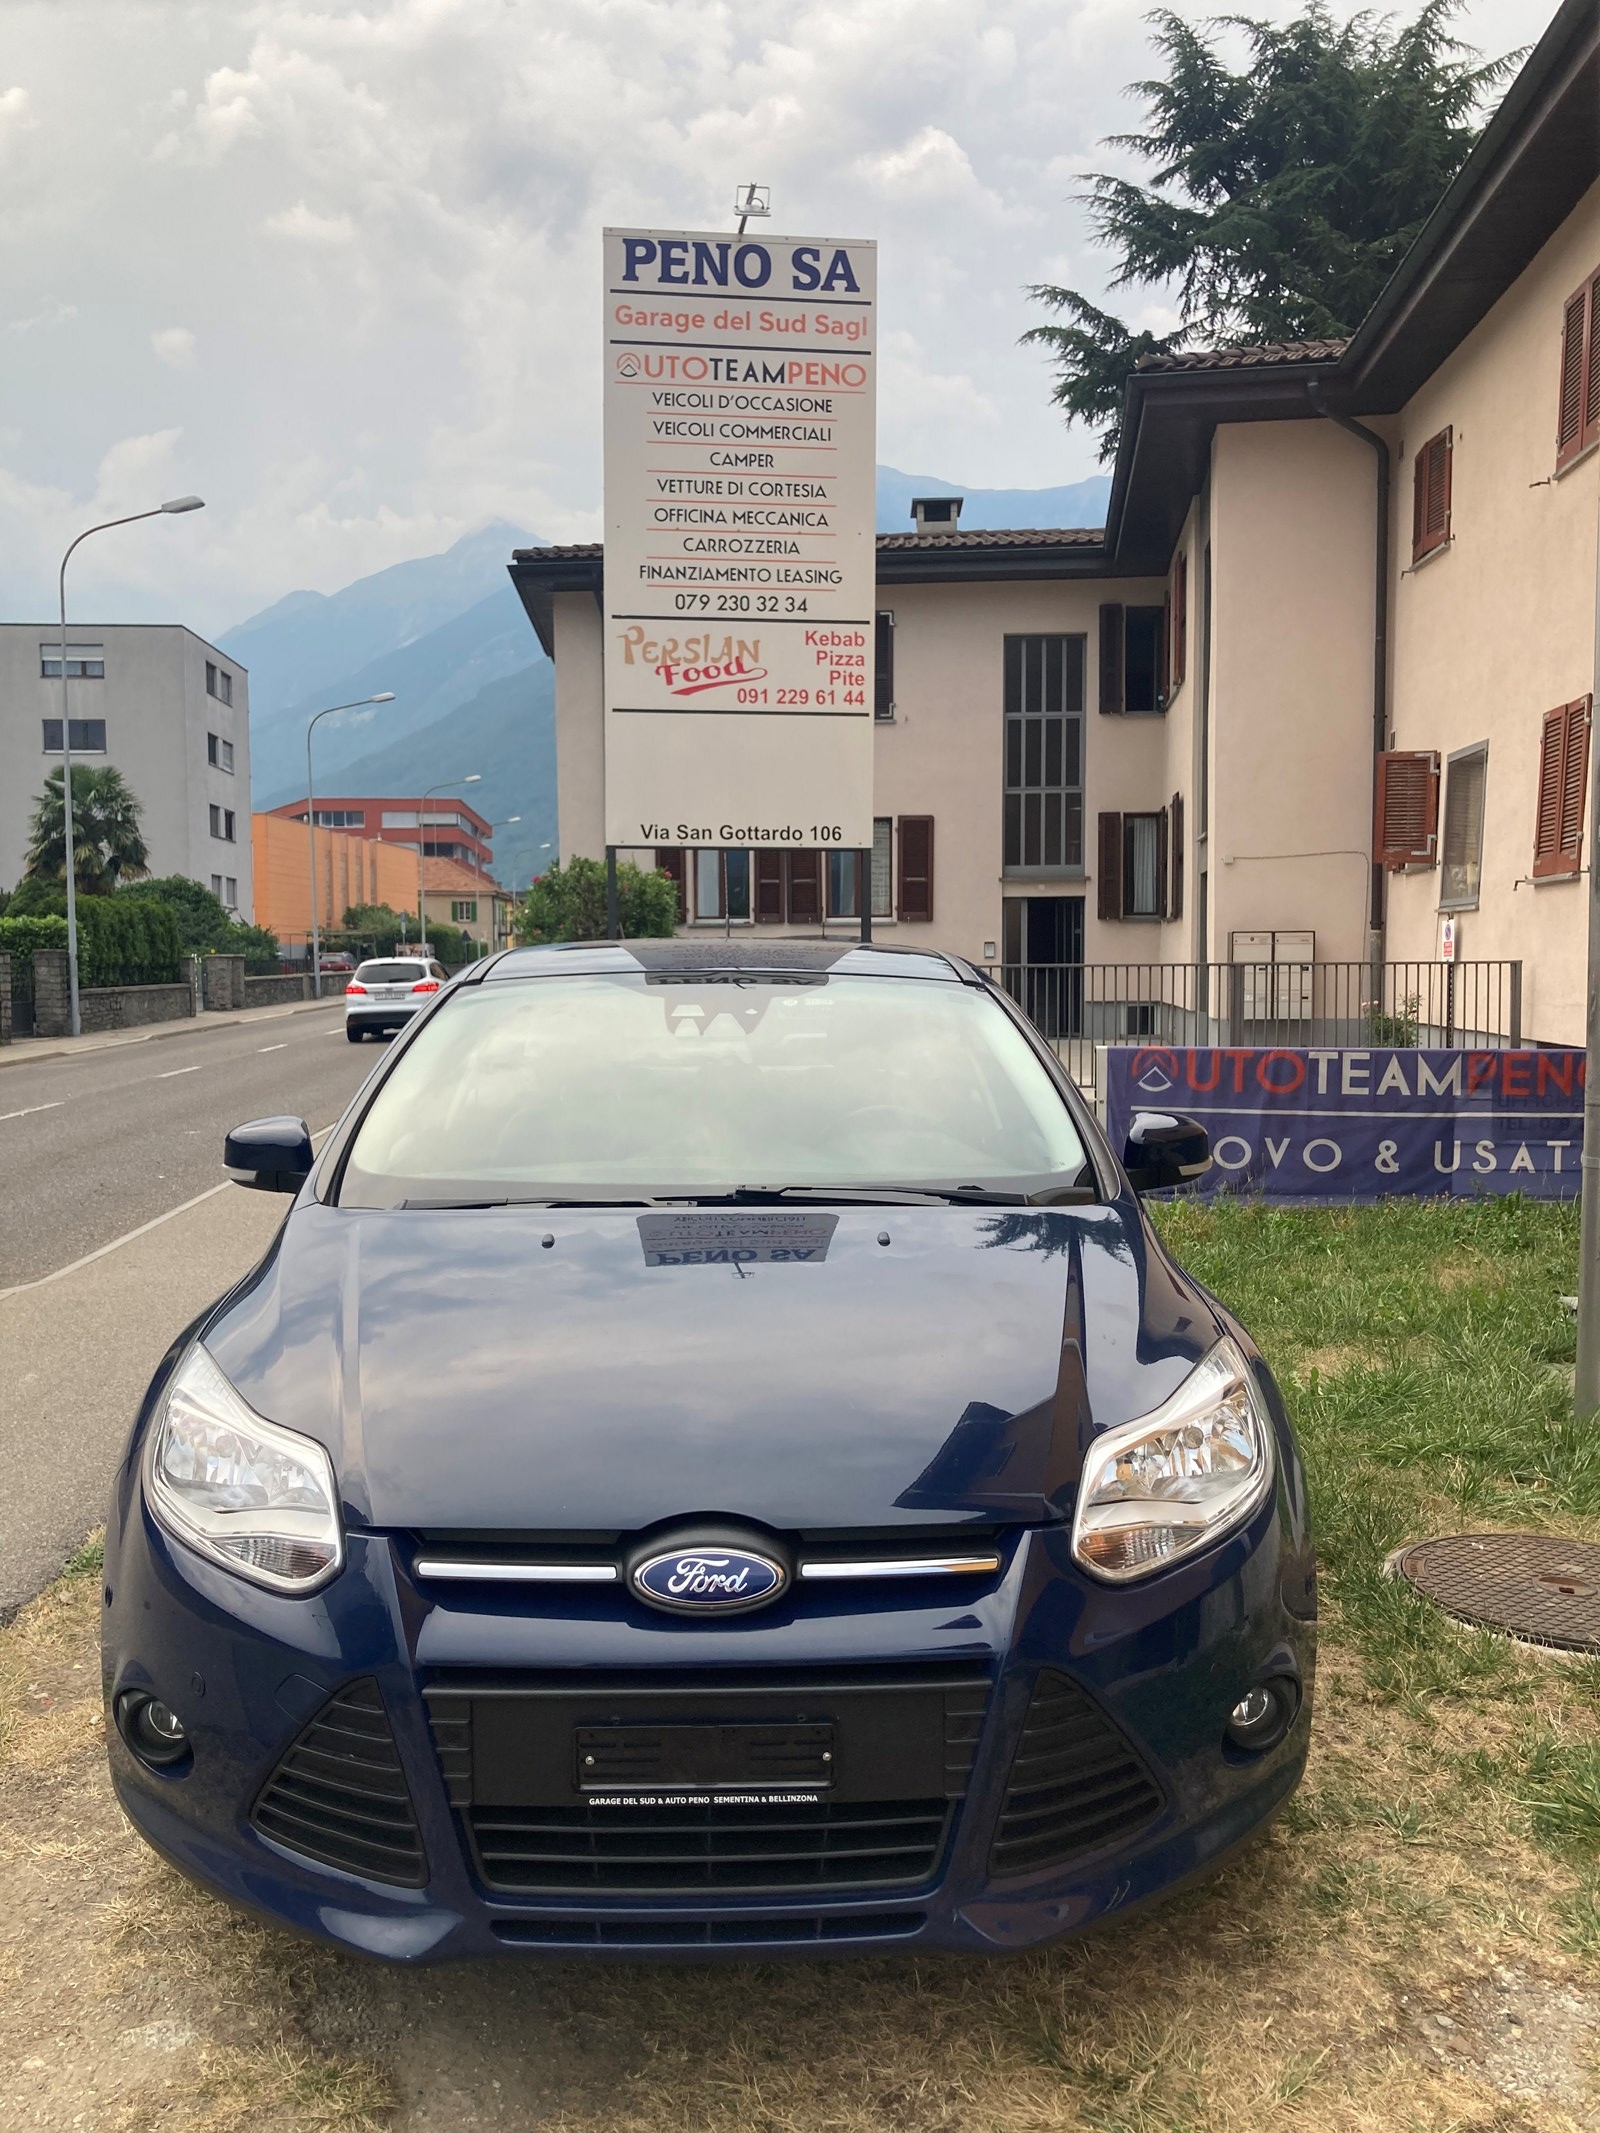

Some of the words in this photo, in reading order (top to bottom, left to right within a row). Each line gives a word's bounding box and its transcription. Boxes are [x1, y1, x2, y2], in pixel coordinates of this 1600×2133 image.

[622, 238, 772, 289] PENO
[791, 246, 861, 293] SA
[614, 304, 706, 333] Garage
[713, 309, 751, 331] del
[759, 311, 806, 333] Sud
[814, 313, 868, 341] Sagl
[652, 392, 713, 409] VEICOLI
[653, 421, 714, 437] VEICOLI
[719, 423, 832, 442] COMMERCIALI
[709, 452, 774, 468] CAMPER
[657, 479, 723, 495] VETTURE
[728, 481, 743, 496] DI
[748, 482, 827, 499] CORTESIA
[654, 507, 728, 524] OFFICINA
[733, 510, 829, 527] MECCANICA
[683, 537, 800, 555] CARROZZERIA
[639, 565, 772, 583] FINANZIAMENTO
[776, 568, 843, 585] LEASING
[675, 593, 711, 611] 079
[717, 594, 750, 612] 230
[756, 596, 779, 613] 32
[785, 596, 808, 613] 34
[804, 630, 865, 647] Kebab
[816, 650, 865, 667] Pizza
[655, 656, 768, 693] Food
[829, 670, 865, 686] Pite
[736, 688, 769, 704] 091
[776, 689, 809, 705] 229
[815, 690, 837, 706] 61
[843, 690, 865, 706] 44
[640, 824, 670, 840] Via
[676, 824, 712, 840] San
[719, 825, 803, 841] Gottardo
[810, 826, 842, 841] 106
[1213, 1135, 1343, 1173] OVO
[1374, 1139, 1400, 1174] &
[1433, 1139, 1584, 1175] USAT
[667, 1557, 750, 1593] Ford
[589, 1797, 621, 1805] GARAGE
[623, 1797, 638, 1805] DEL
[639, 1797, 656, 1805] SUD
[657, 1797, 664, 1805] &
[665, 1796, 687, 1805] AUTO
[688, 1796, 710, 1804] PENO
[713, 1796, 760, 1804] SEMENTINA
[768, 1795, 818, 1803] BELLINZONA
